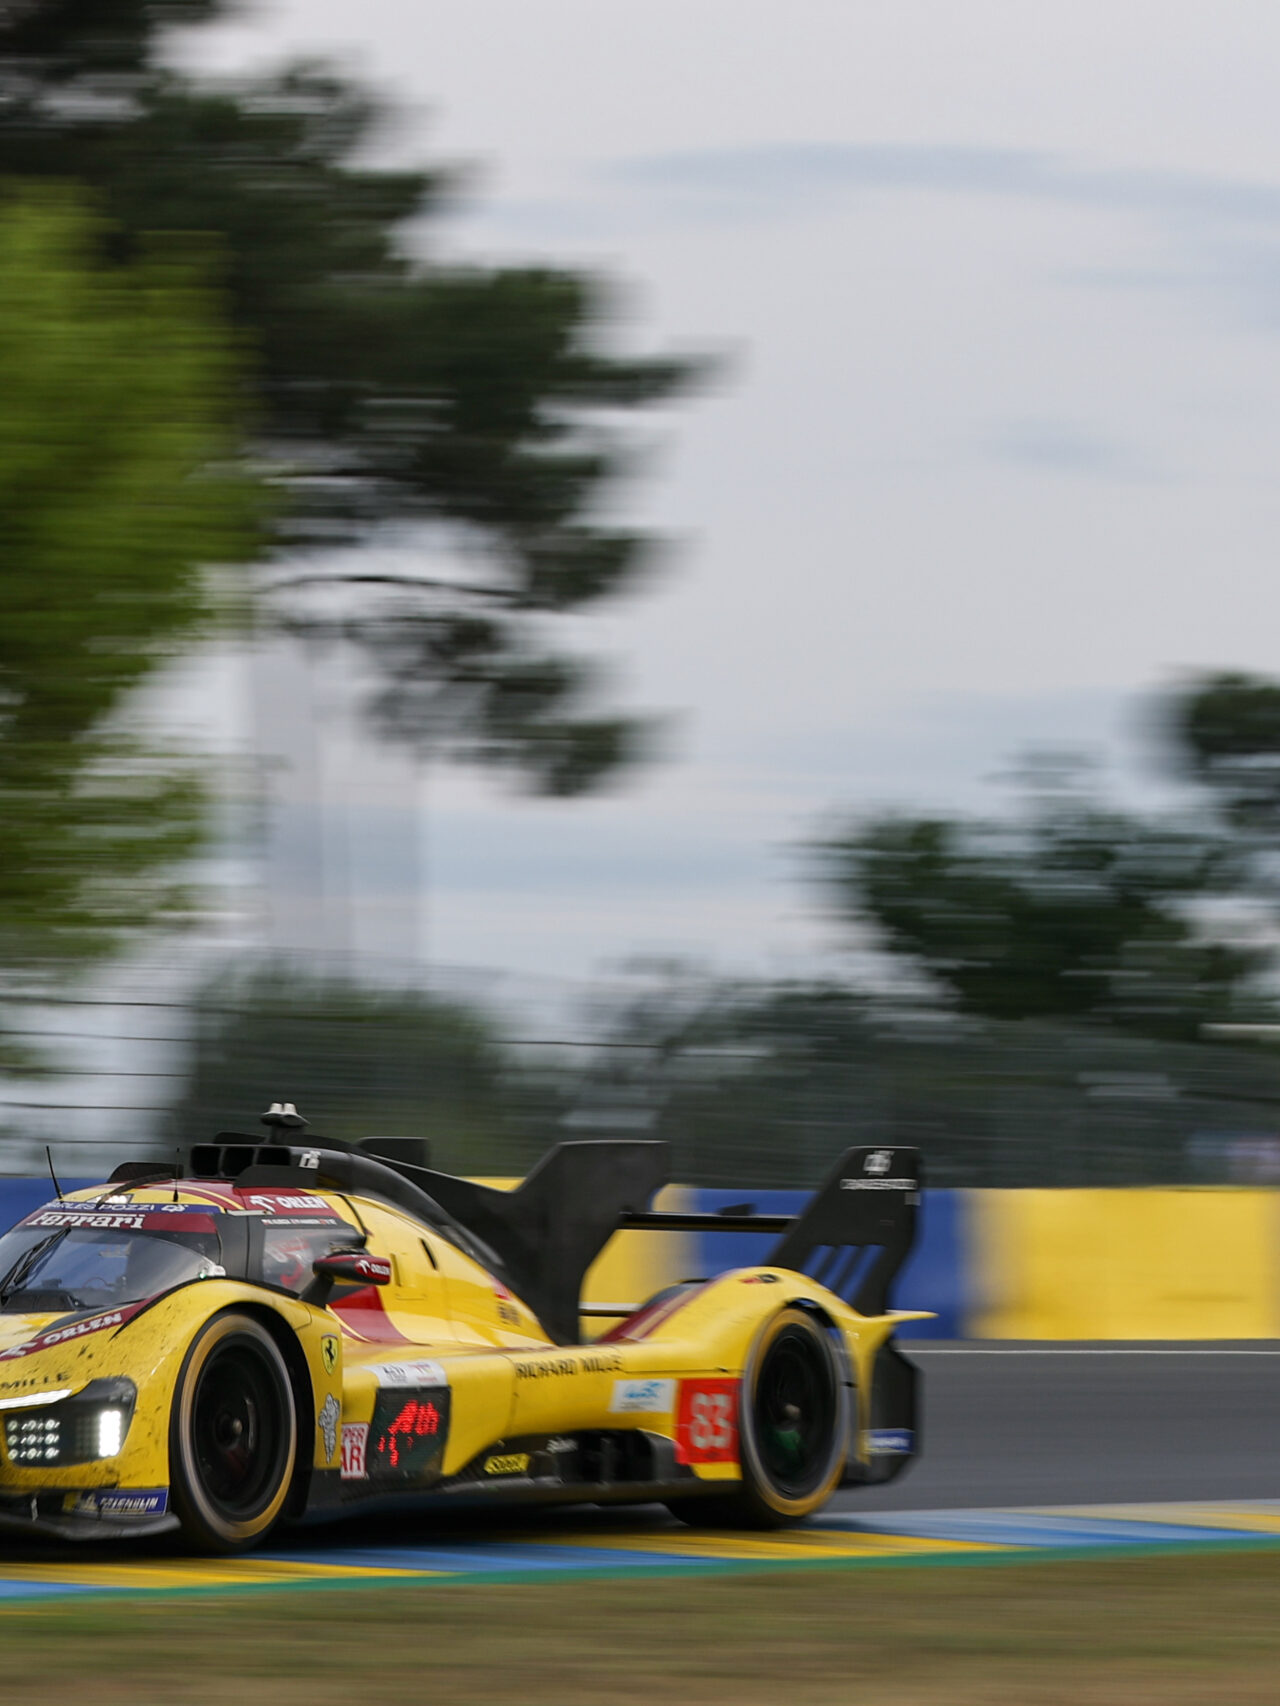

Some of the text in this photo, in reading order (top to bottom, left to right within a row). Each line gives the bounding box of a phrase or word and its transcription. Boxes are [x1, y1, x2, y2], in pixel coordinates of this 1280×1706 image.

[98, 1203, 154, 1212] POZZI
[276, 1195, 330, 1209] ORLEN
[27, 1212, 146, 1229] Ferrari
[43, 1313, 123, 1344] ORLEN
[0, 1372, 70, 1389] MILLE
[689, 1392, 733, 1449] 83
